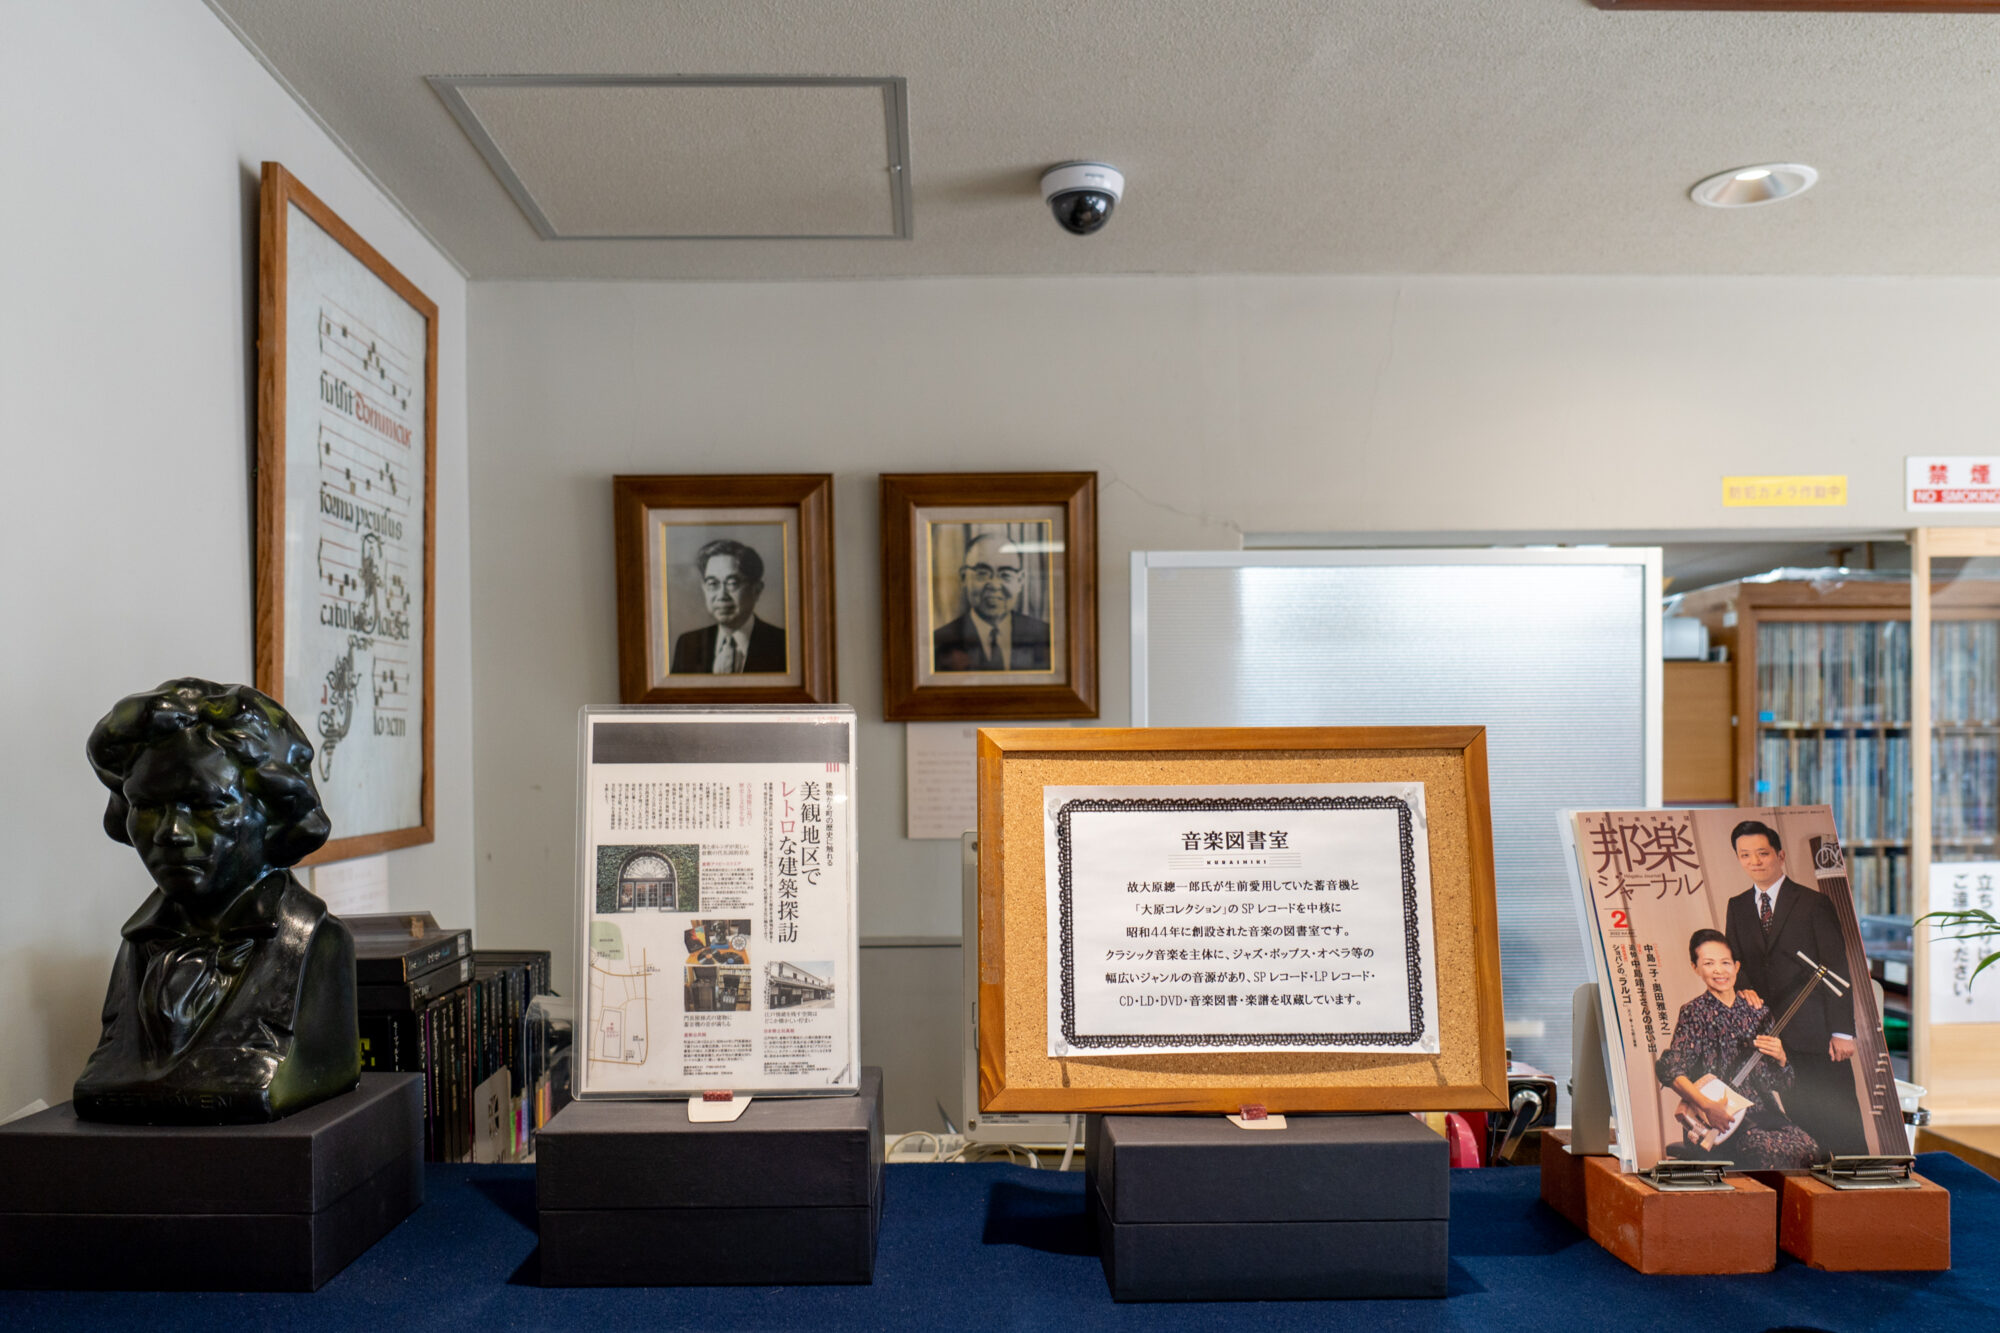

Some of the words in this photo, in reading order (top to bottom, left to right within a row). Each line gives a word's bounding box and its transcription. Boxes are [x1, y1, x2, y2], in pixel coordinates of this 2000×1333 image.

[1929, 464, 1990, 484] 禁煙
[1916, 490, 1937, 502] NO
[800, 781, 821, 885] 美観地区で
[1181, 830, 1290, 851] 音楽図書室
[1589, 822, 1700, 874] 邦楽
[777, 781, 799, 943] レトロな建築探訪
[1127, 879, 1360, 893] 故大原總一郎氏が生前愛用していた蓄音機と
[1598, 871, 1704, 900] ジャーナル
[1610, 910, 1629, 928] 2
